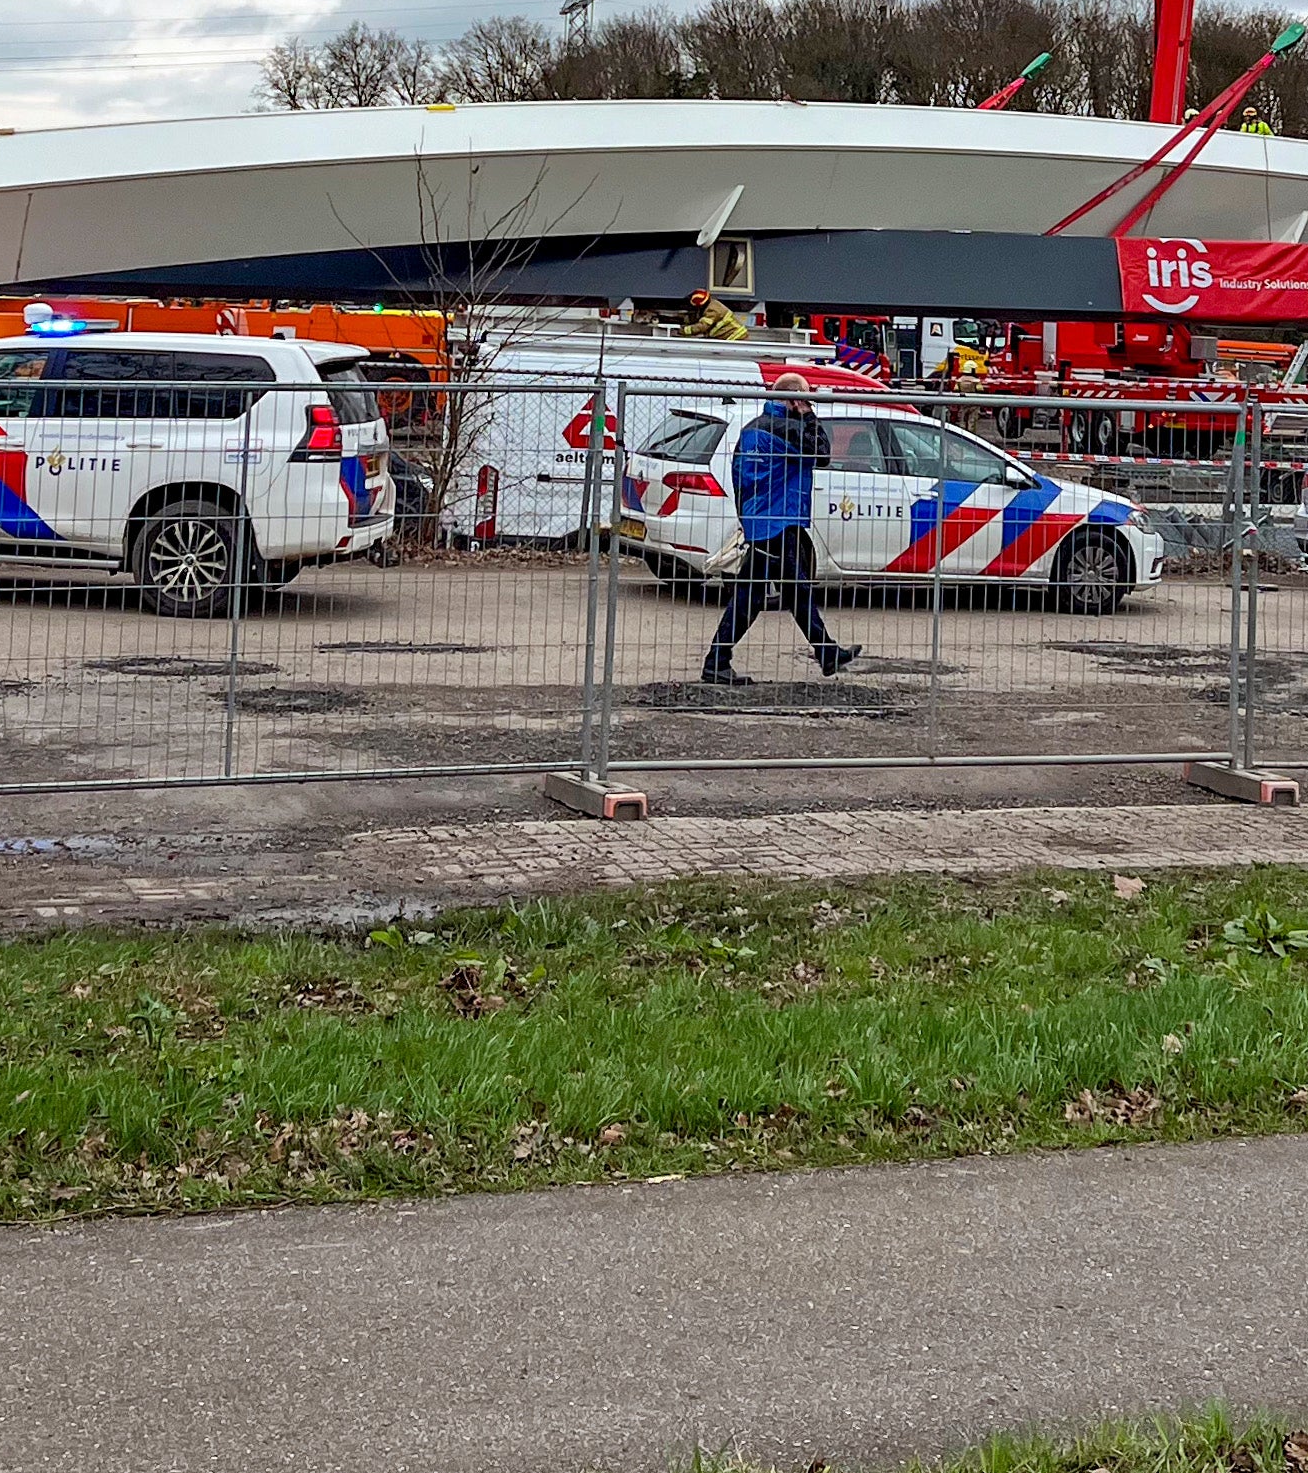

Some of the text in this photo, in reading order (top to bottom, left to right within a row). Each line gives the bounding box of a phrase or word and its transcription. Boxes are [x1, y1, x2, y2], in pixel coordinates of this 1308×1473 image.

[1146, 246, 1214, 288] iris
[1219, 278, 1263, 292] Industry
[35, 454, 122, 476] POLITIE
[829, 502, 904, 522] POLITIE
